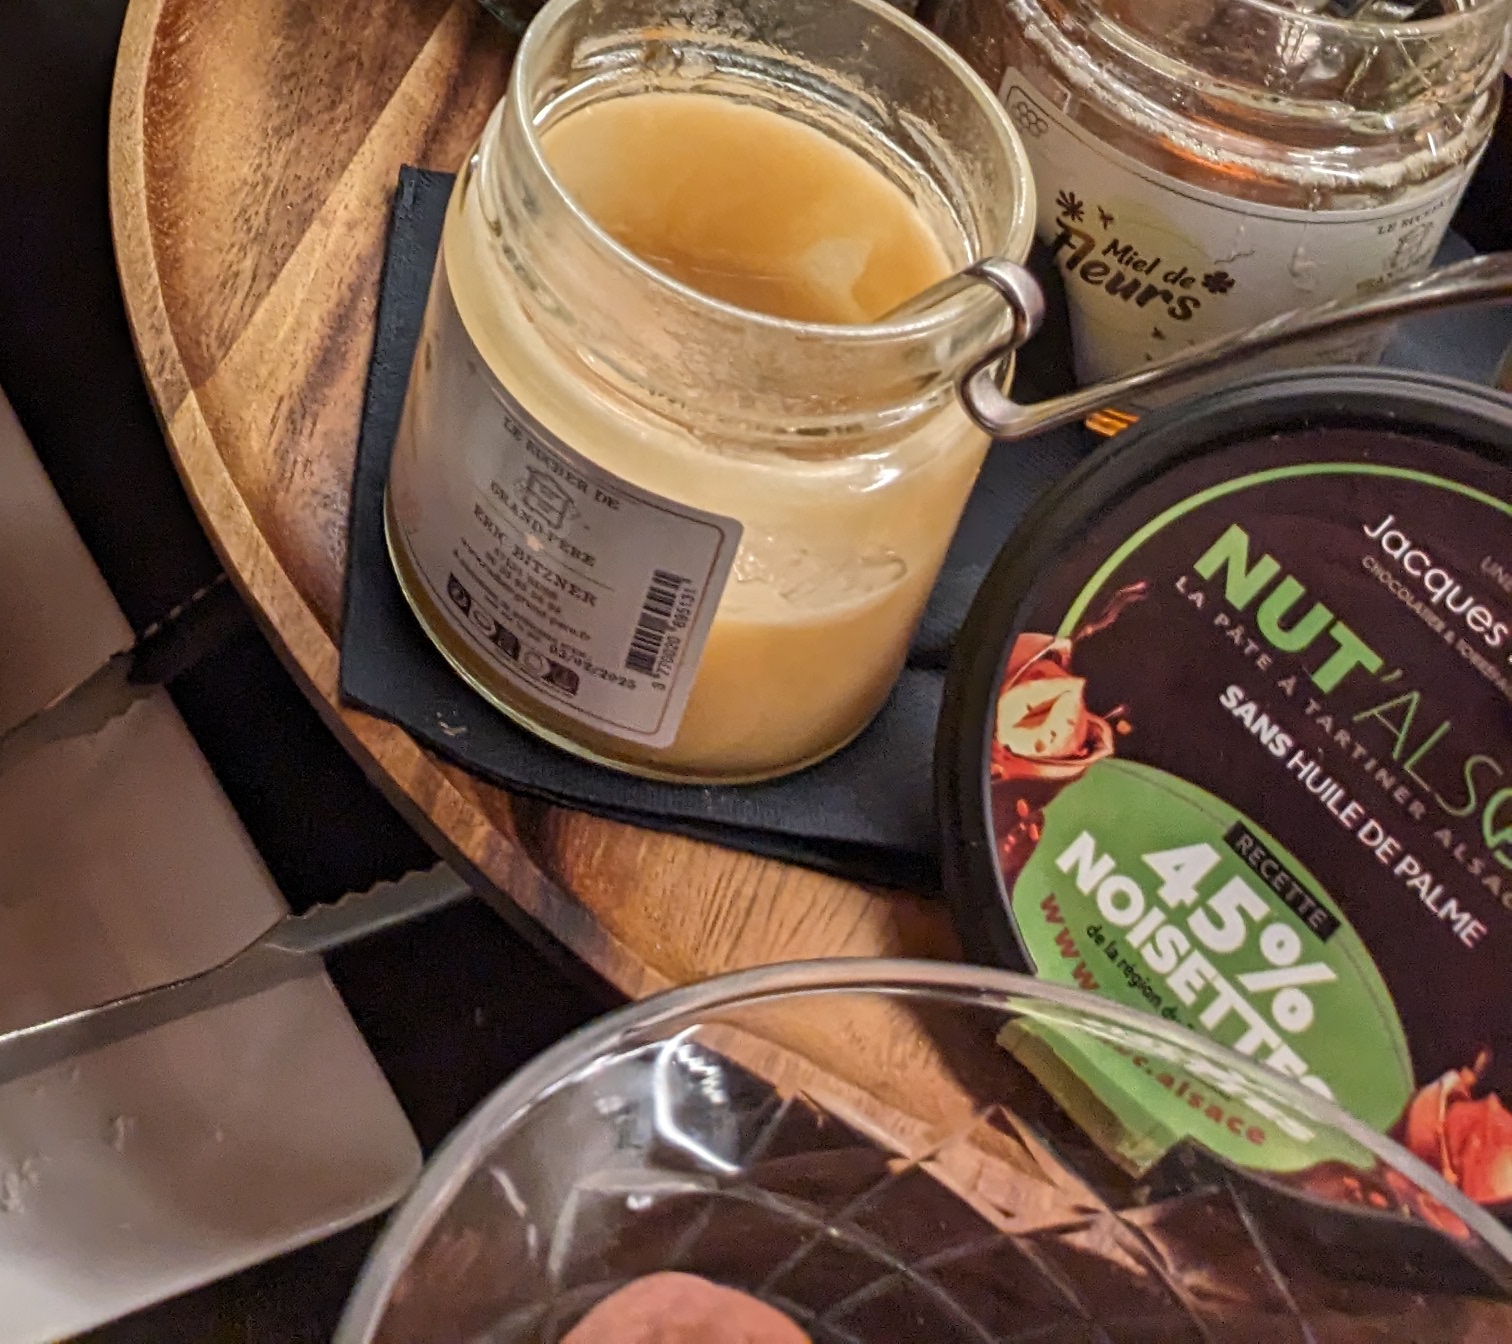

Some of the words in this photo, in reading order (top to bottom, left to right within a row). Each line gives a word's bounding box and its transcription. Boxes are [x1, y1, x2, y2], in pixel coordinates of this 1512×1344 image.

[1051, 216, 1202, 323] Fleurs
[1101, 238, 1161, 275] Miel
[1163, 265, 1196, 291] de
[595, 488, 620, 511] DE
[1363, 514, 1509, 647] Jacques
[1174, 575, 1205, 610] LA
[1213, 612, 1273, 670] PÂTE
[1305, 698, 1427, 821] TARTINER
[1219, 683, 1294, 759] SANS
[1286, 749, 1365, 830] HUILE
[1356, 818, 1403, 865] DE
[1393, 853, 1488, 949] PALME
[1234, 831, 1331, 931] RECETTE
[1086, 923, 1104, 946] de
[1103, 940, 1118, 962] la
[1141, 842, 1338, 1034] 45%
